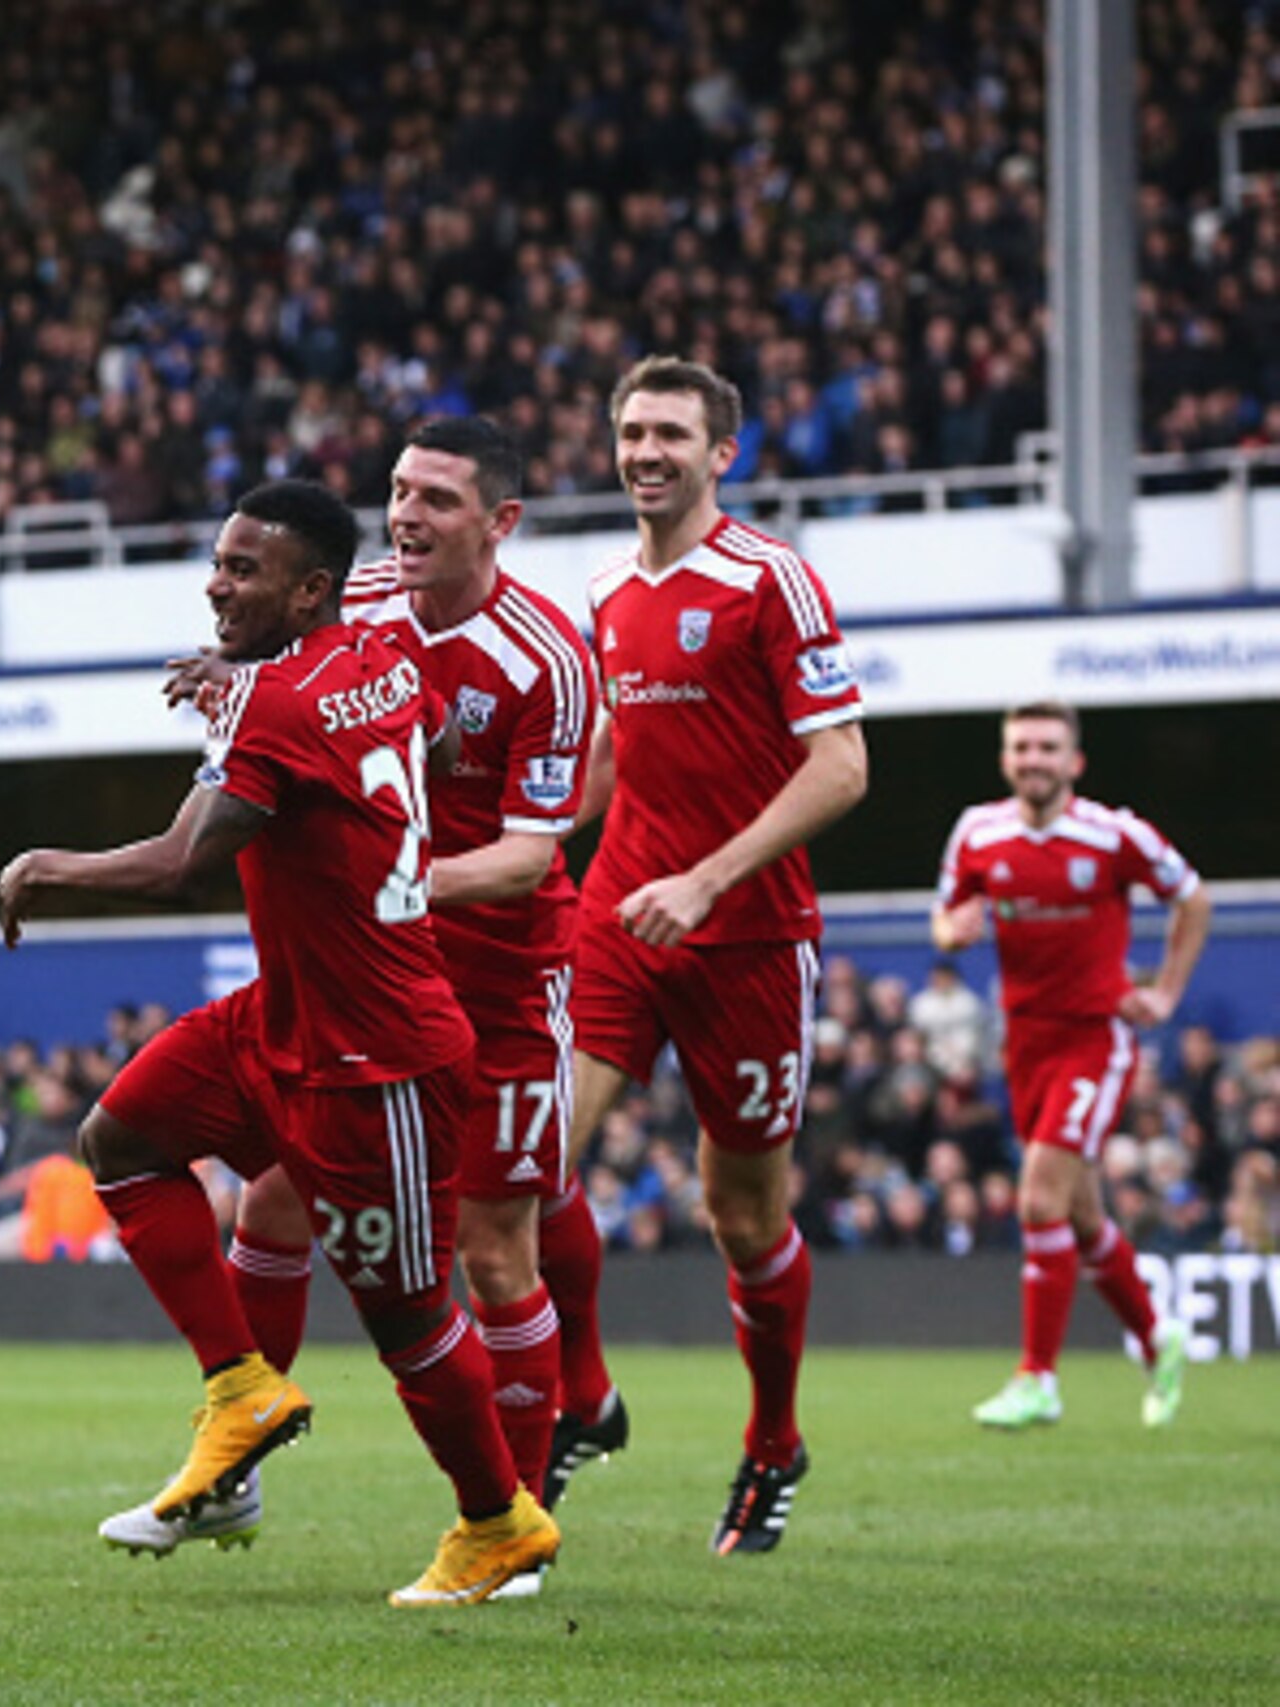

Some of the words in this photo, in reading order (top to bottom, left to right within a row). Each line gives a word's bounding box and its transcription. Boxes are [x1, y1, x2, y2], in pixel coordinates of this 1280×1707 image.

[494, 1080, 557, 1152] 17
[736, 1051, 800, 1119] 23
[313, 1196, 393, 1265] 29
